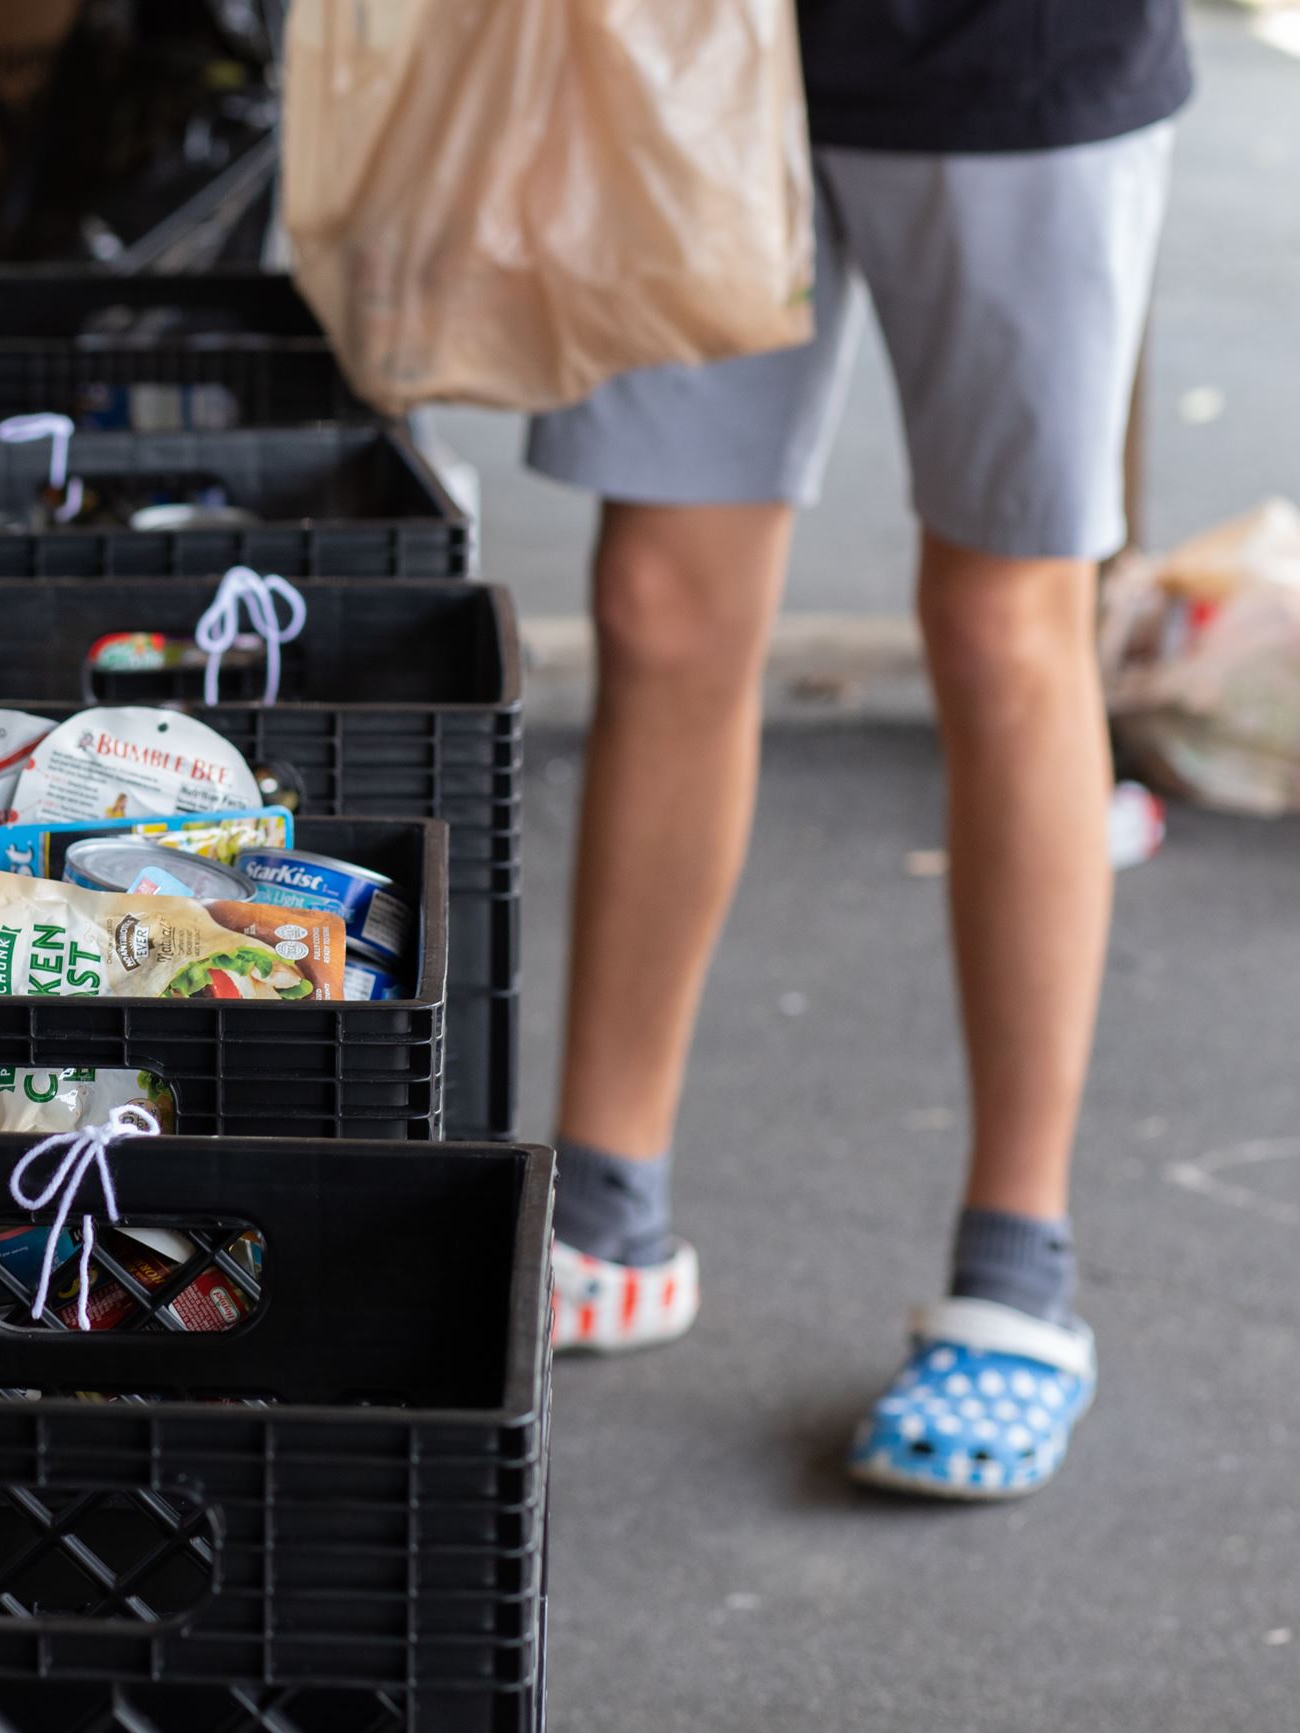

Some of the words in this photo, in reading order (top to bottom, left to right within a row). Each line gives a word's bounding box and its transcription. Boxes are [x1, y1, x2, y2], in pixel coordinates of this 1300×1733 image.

[96, 733, 183, 774] BUMBLE
[190, 758, 226, 784] BEE
[245, 860, 323, 891] StarKist
[135, 929, 149, 957] EVER
[27, 923, 66, 996] KEN
[212, 1292, 236, 1320] Hormel
